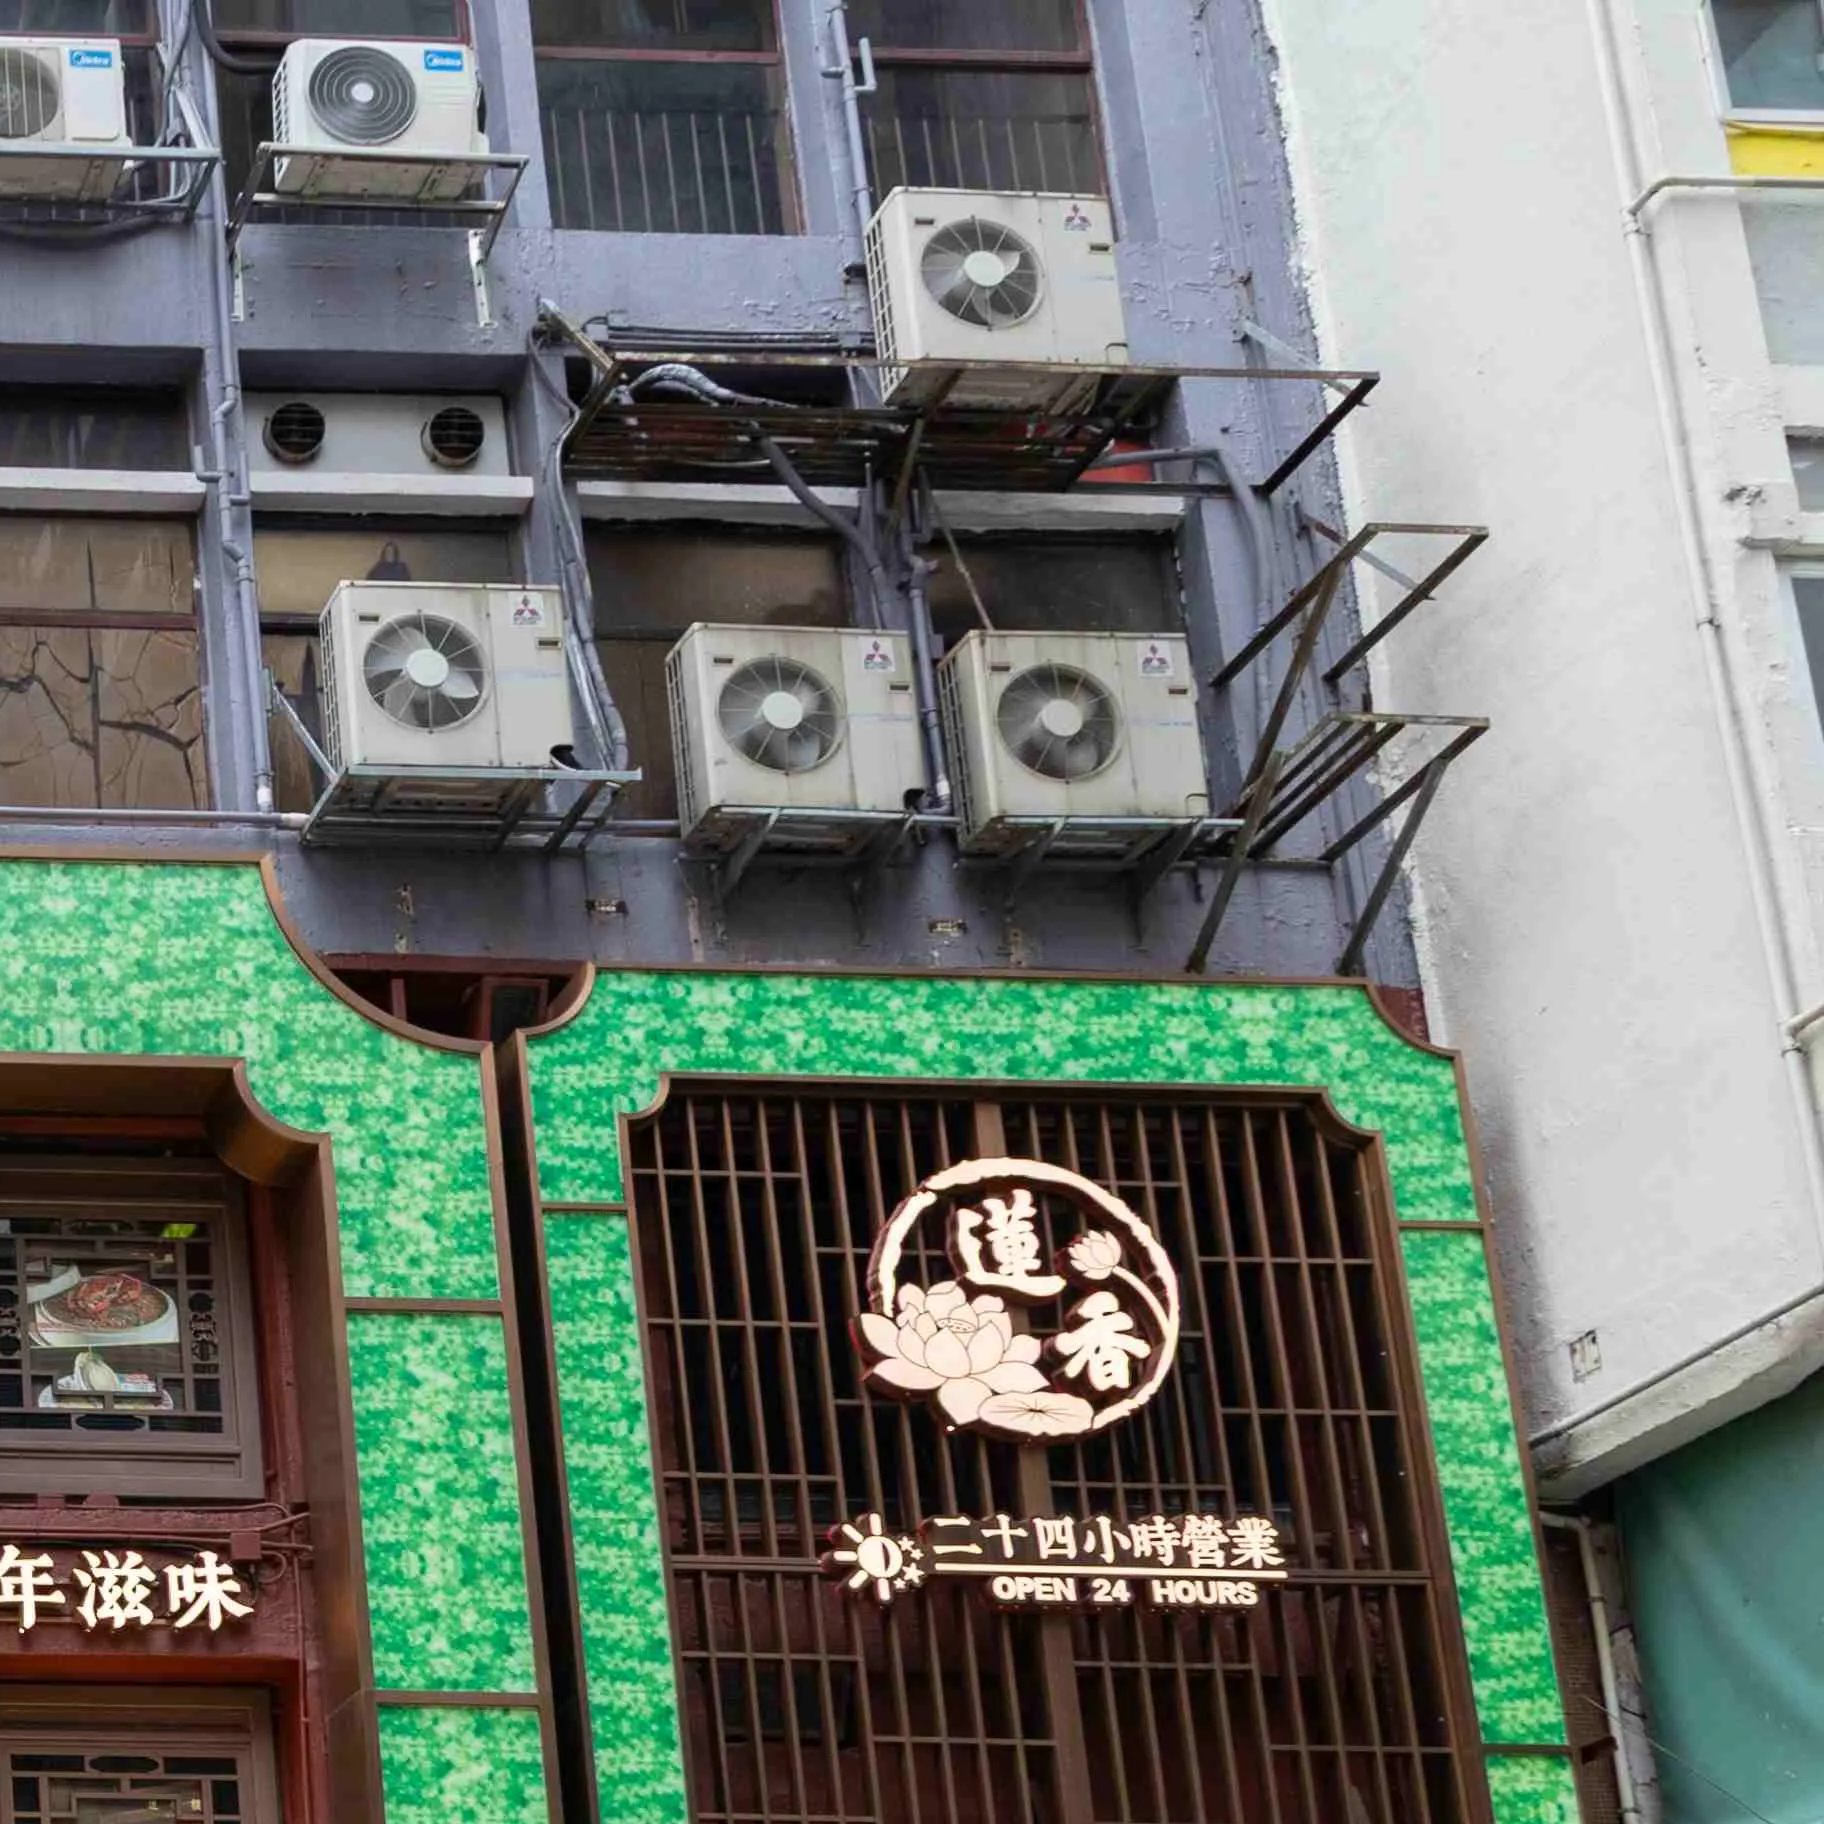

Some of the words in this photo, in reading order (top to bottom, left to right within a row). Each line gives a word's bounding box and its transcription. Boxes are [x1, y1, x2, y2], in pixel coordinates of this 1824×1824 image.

[932, 1515, 1286, 1572] 二十四小時營業
[992, 1577, 1077, 1603] OPEN
[1092, 1578, 1131, 1603] 24
[1152, 1578, 1257, 1605] HOURS
